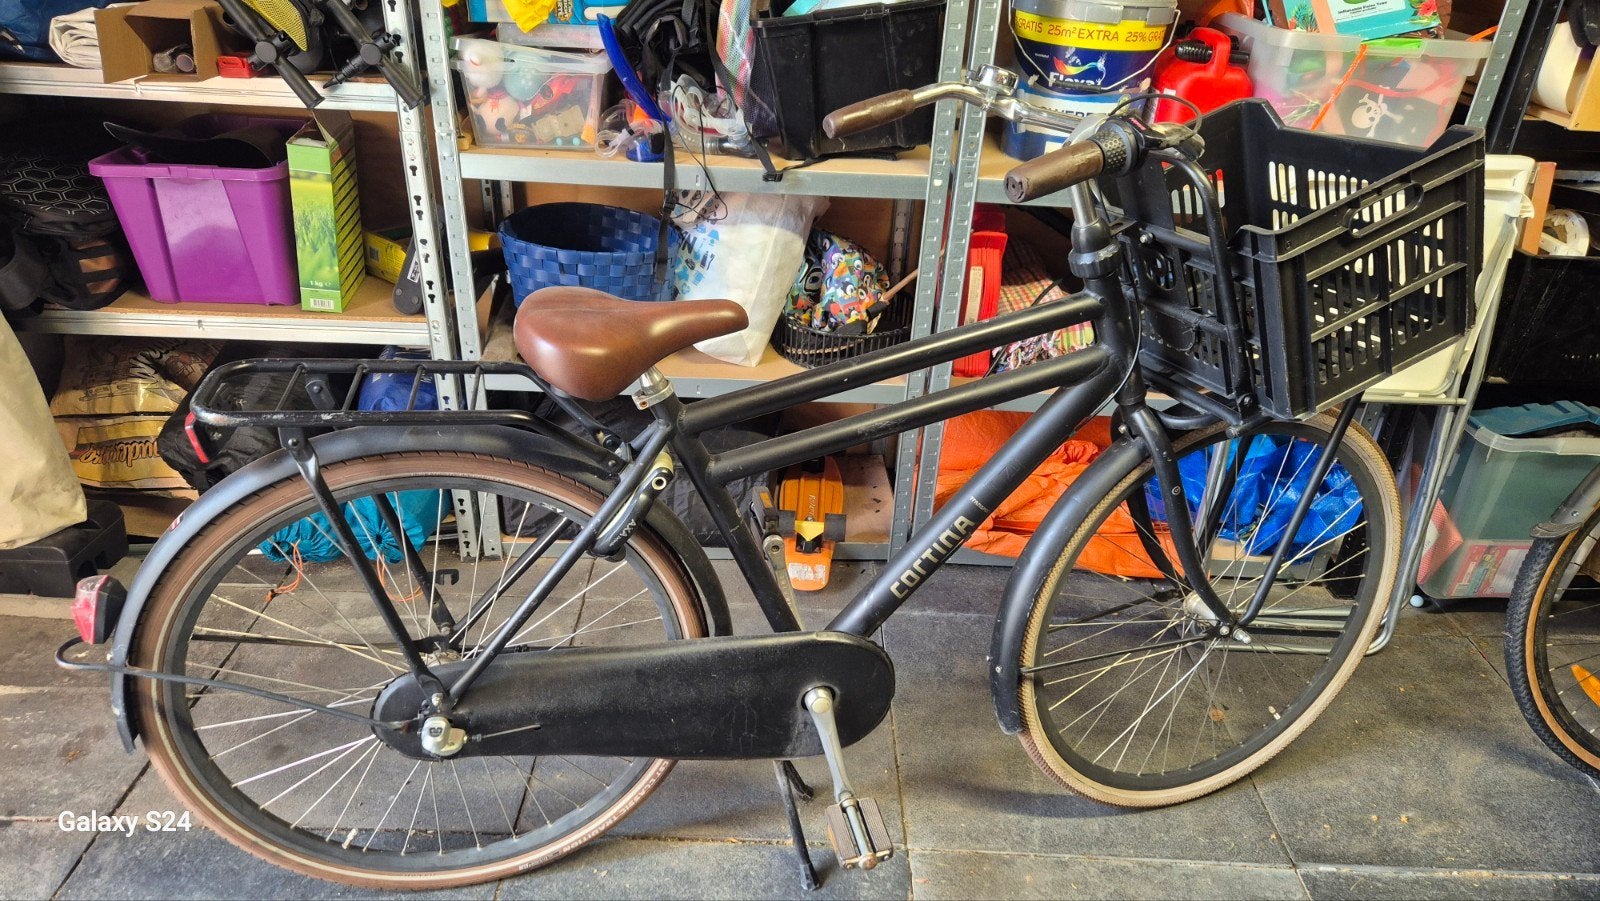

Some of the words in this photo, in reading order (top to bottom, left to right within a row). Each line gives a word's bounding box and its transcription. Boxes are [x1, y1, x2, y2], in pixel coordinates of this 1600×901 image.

[1018, 17, 1043, 33] GRATIS
[1078, 27, 1119, 42] EXTRA
[1125, 31, 1147, 43] 25%
[619, 518, 637, 537] AXA
[617, 778, 656, 816] CLASSIC
[562, 814, 619, 853] TRADITION
